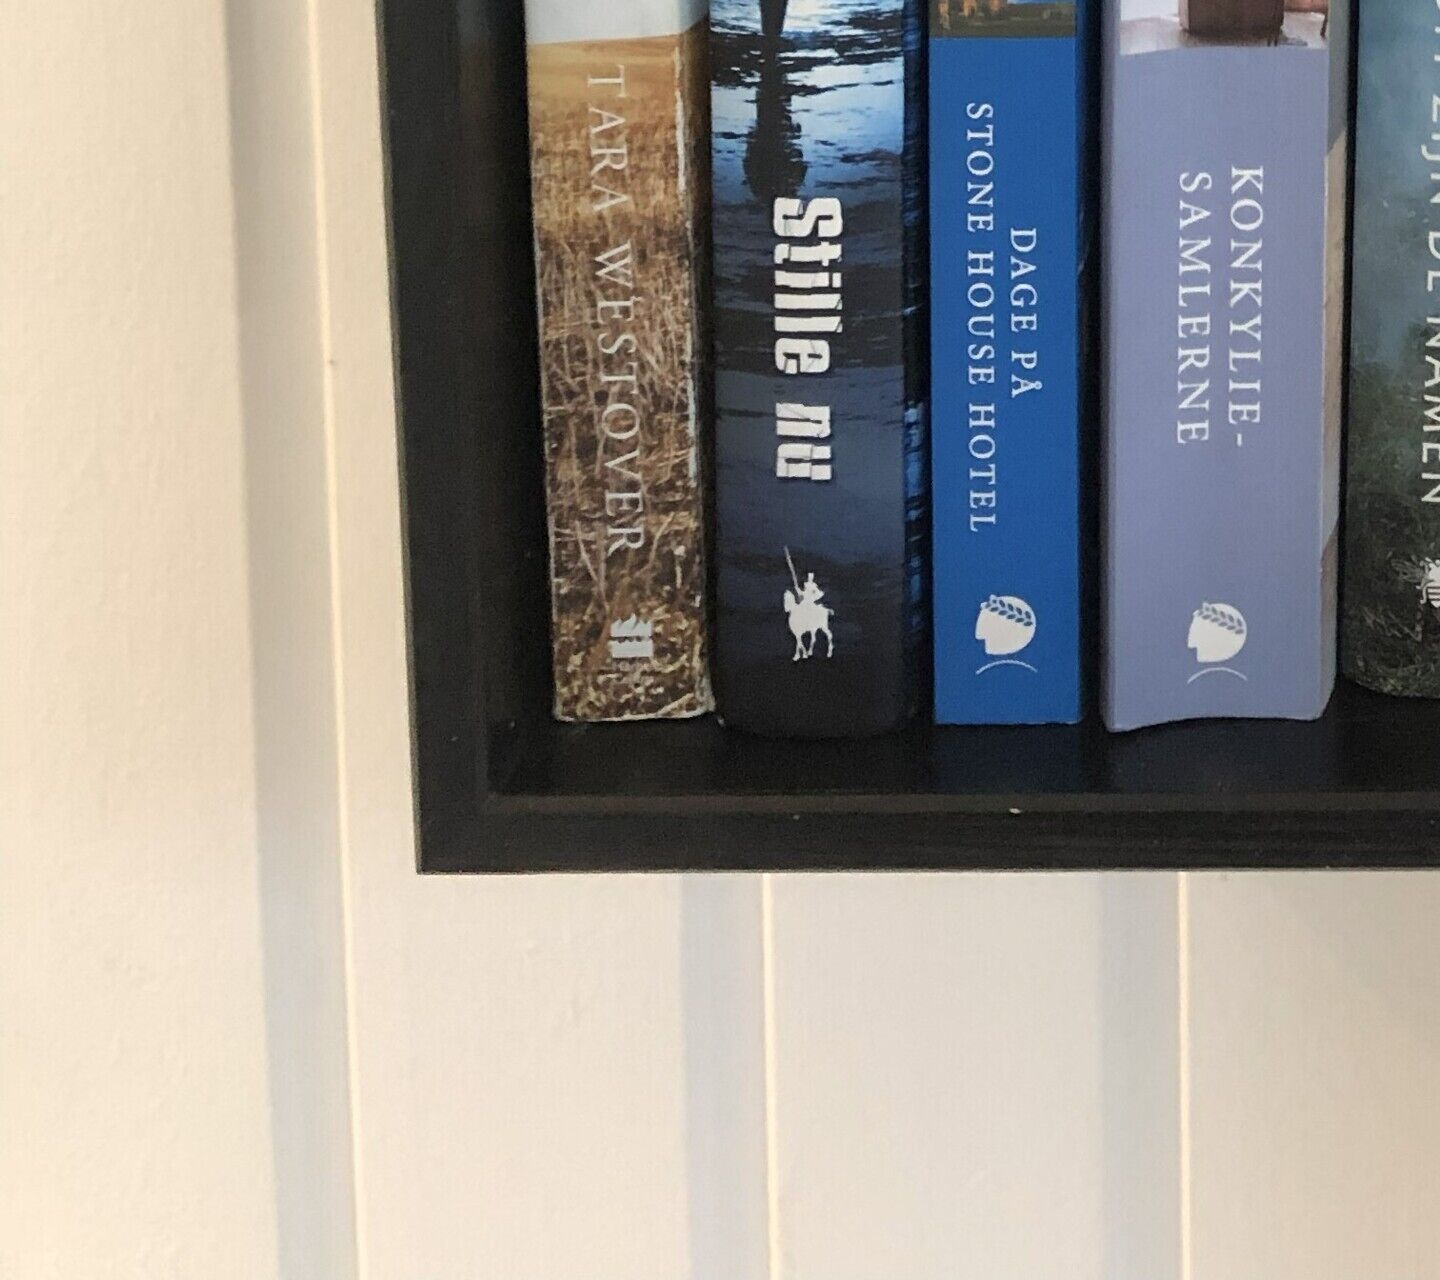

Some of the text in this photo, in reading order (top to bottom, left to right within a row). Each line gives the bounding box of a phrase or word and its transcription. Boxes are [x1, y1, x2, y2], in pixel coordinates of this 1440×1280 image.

[588, 65, 646, 557] TARA WESTOVER
[772, 196, 844, 482] Stille nu
[967, 102, 997, 532] STONE HOUSE HOTEL
[1010, 227, 1043, 399] DAGE PÅ
[1176, 172, 1213, 446] SAMLERNE
[1227, 164, 1264, 448] KONKYLIE-
